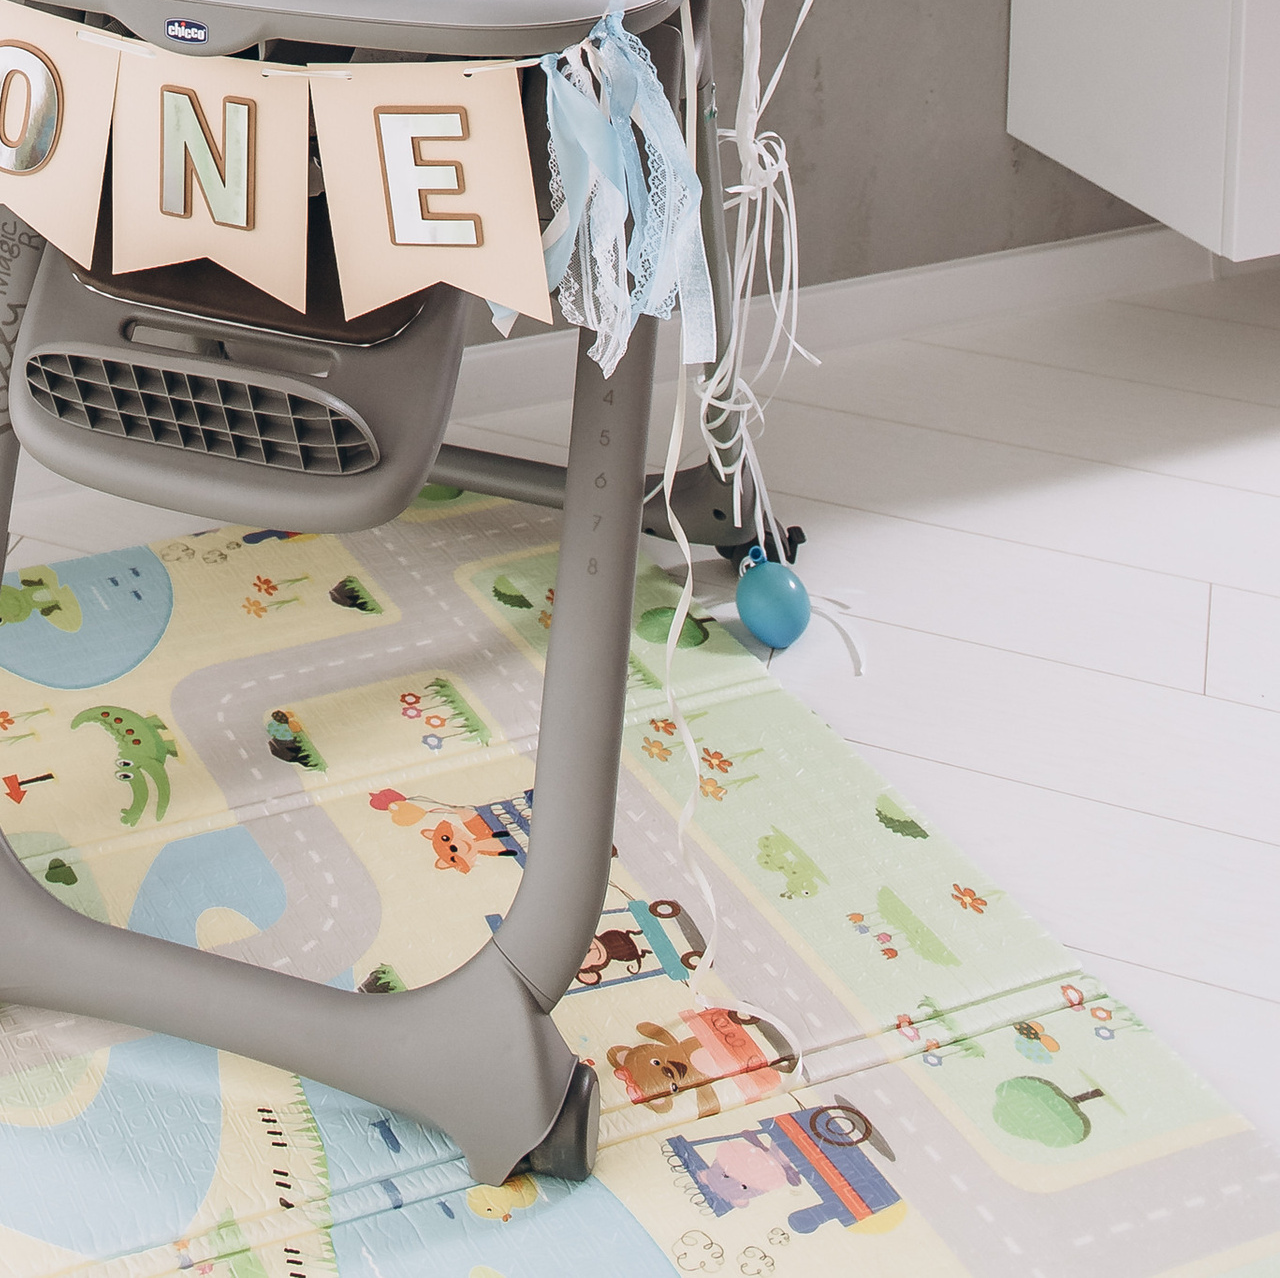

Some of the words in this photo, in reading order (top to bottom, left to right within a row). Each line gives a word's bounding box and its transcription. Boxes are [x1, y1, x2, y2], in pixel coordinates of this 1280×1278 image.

[167, 20, 206, 41] chicco
[603, 389, 614, 406] 4
[599, 429, 610, 446] 5
[594, 472, 607, 489] 6
[592, 515, 602, 531] 7
[586, 557, 598, 575] 8
